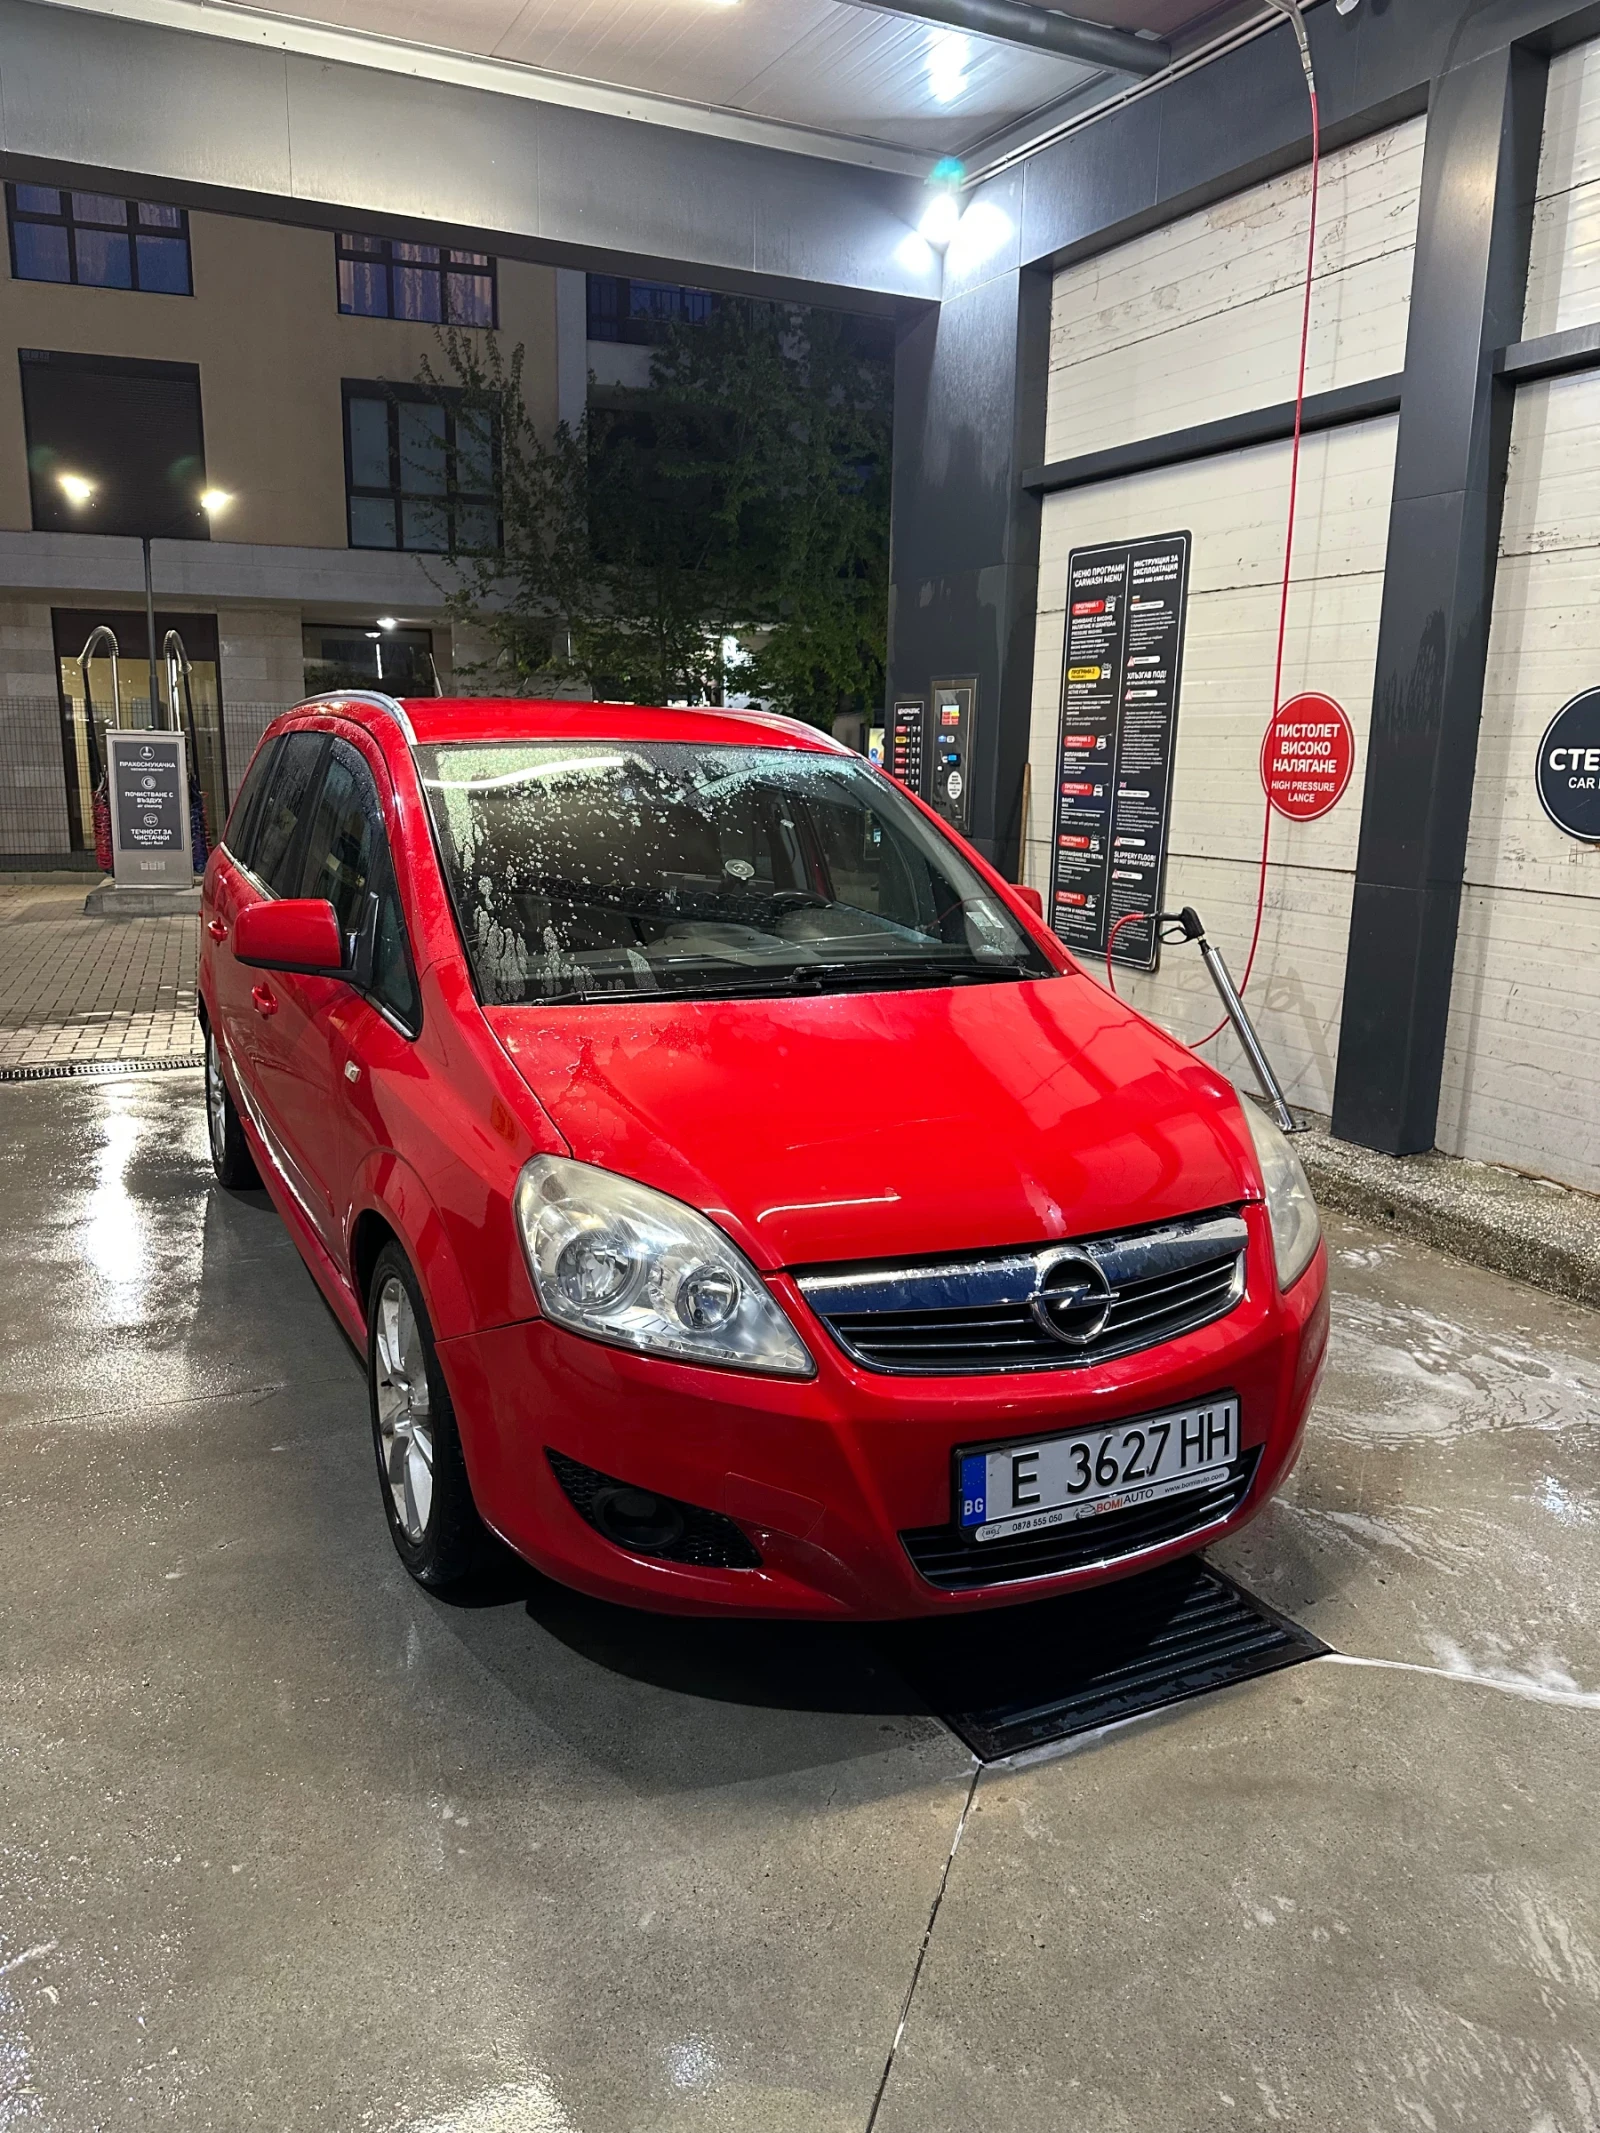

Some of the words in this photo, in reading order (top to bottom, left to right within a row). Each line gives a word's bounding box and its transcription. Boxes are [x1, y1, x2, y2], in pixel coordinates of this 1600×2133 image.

[1134, 556, 1170, 568] ИНСТРУКЦИЯ
[1171, 554, 1178, 562] ЗА
[1073, 568, 1091, 579] МЕНЮ
[1092, 563, 1125, 575] ПРОГРАМИ
[1133, 563, 1178, 576] ЕКСПЛОАТАЦИЯ
[1075, 575, 1103, 588] CARWASH
[1104, 573, 1122, 583] MENU
[1127, 671, 1152, 679] ХЛЪЗГАВ
[1152, 670, 1167, 678] ПОД!
[1275, 724, 1340, 738] ПИСТОЛЕТ
[1280, 741, 1331, 756] ВИСОКО
[1272, 758, 1337, 773] НАЛЯГАНЕ
[1549, 748, 1600, 771] СТЕ
[1271, 780, 1291, 790] HIGH
[1292, 781, 1335, 792] PRESSURE
[1568, 777, 1595, 789] CAR
[1288, 792, 1315, 803] LANCE
[1114, 851, 1138, 860] SLIPPERY
[1012, 1452, 1040, 1508] E
[1066, 1422, 1170, 1494] 3627
[1180, 1406, 1230, 1468] HH
[964, 1498, 984, 1516] BG
[1012, 1521, 1031, 1532] 0878
[1034, 1517, 1047, 1527] 555
[1048, 1513, 1063, 1523] 050
[1164, 1472, 1225, 1493] www.bomiauto.com
